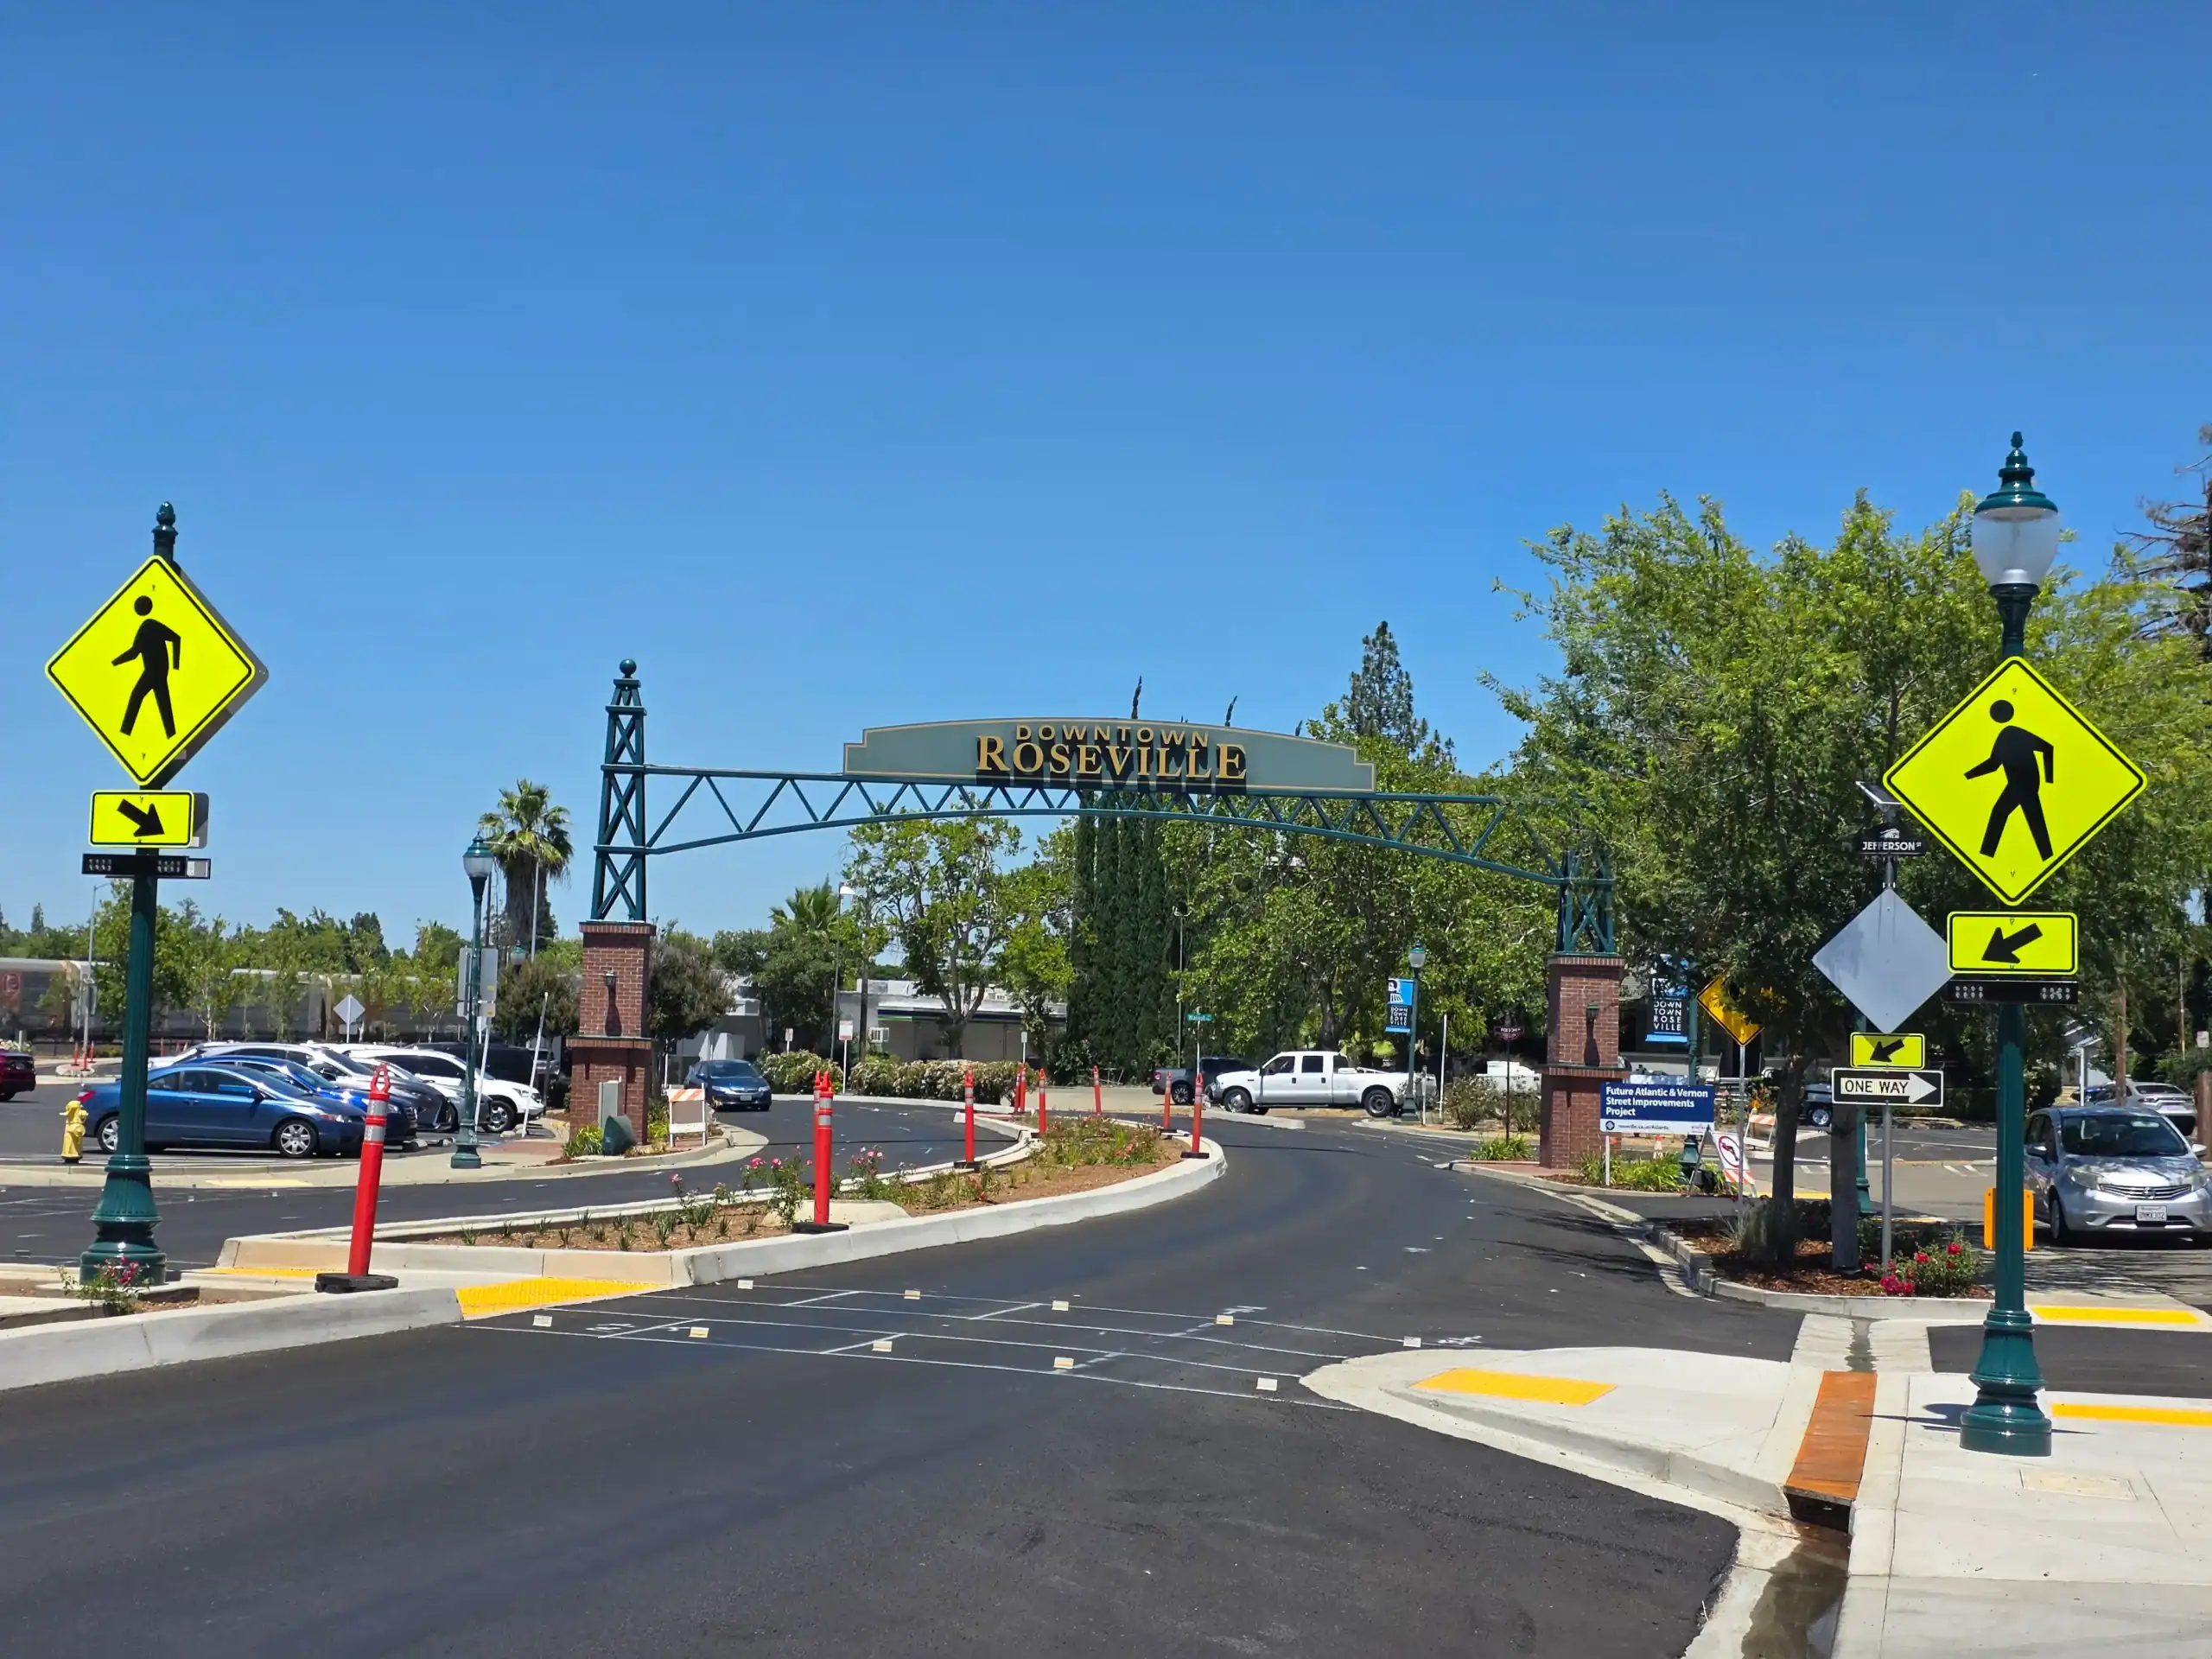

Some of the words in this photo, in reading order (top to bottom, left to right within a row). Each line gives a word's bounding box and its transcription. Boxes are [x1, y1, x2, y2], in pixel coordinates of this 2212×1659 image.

[1015, 724, 1209, 747] DOWNTOWN
[976, 735, 1247, 779] ROSEVILLE
[1862, 841, 1916, 851] JEFFERSON
[1653, 1014, 1681, 1024] ROSE
[1653, 1022, 1681, 1031] VILLE
[1605, 1086, 1634, 1096] Future
[1635, 1087, 1669, 1096] Atlantic
[1669, 1088, 1676, 1096] &
[1676, 1088, 1708, 1097] Vernon
[1845, 1080, 1873, 1093] ONE
[1878, 1081, 1909, 1094] WAY
[1605, 1096, 1631, 1106] Street
[1632, 1097, 1694, 1108] Improvements
[1605, 1107, 1636, 1117] Project
